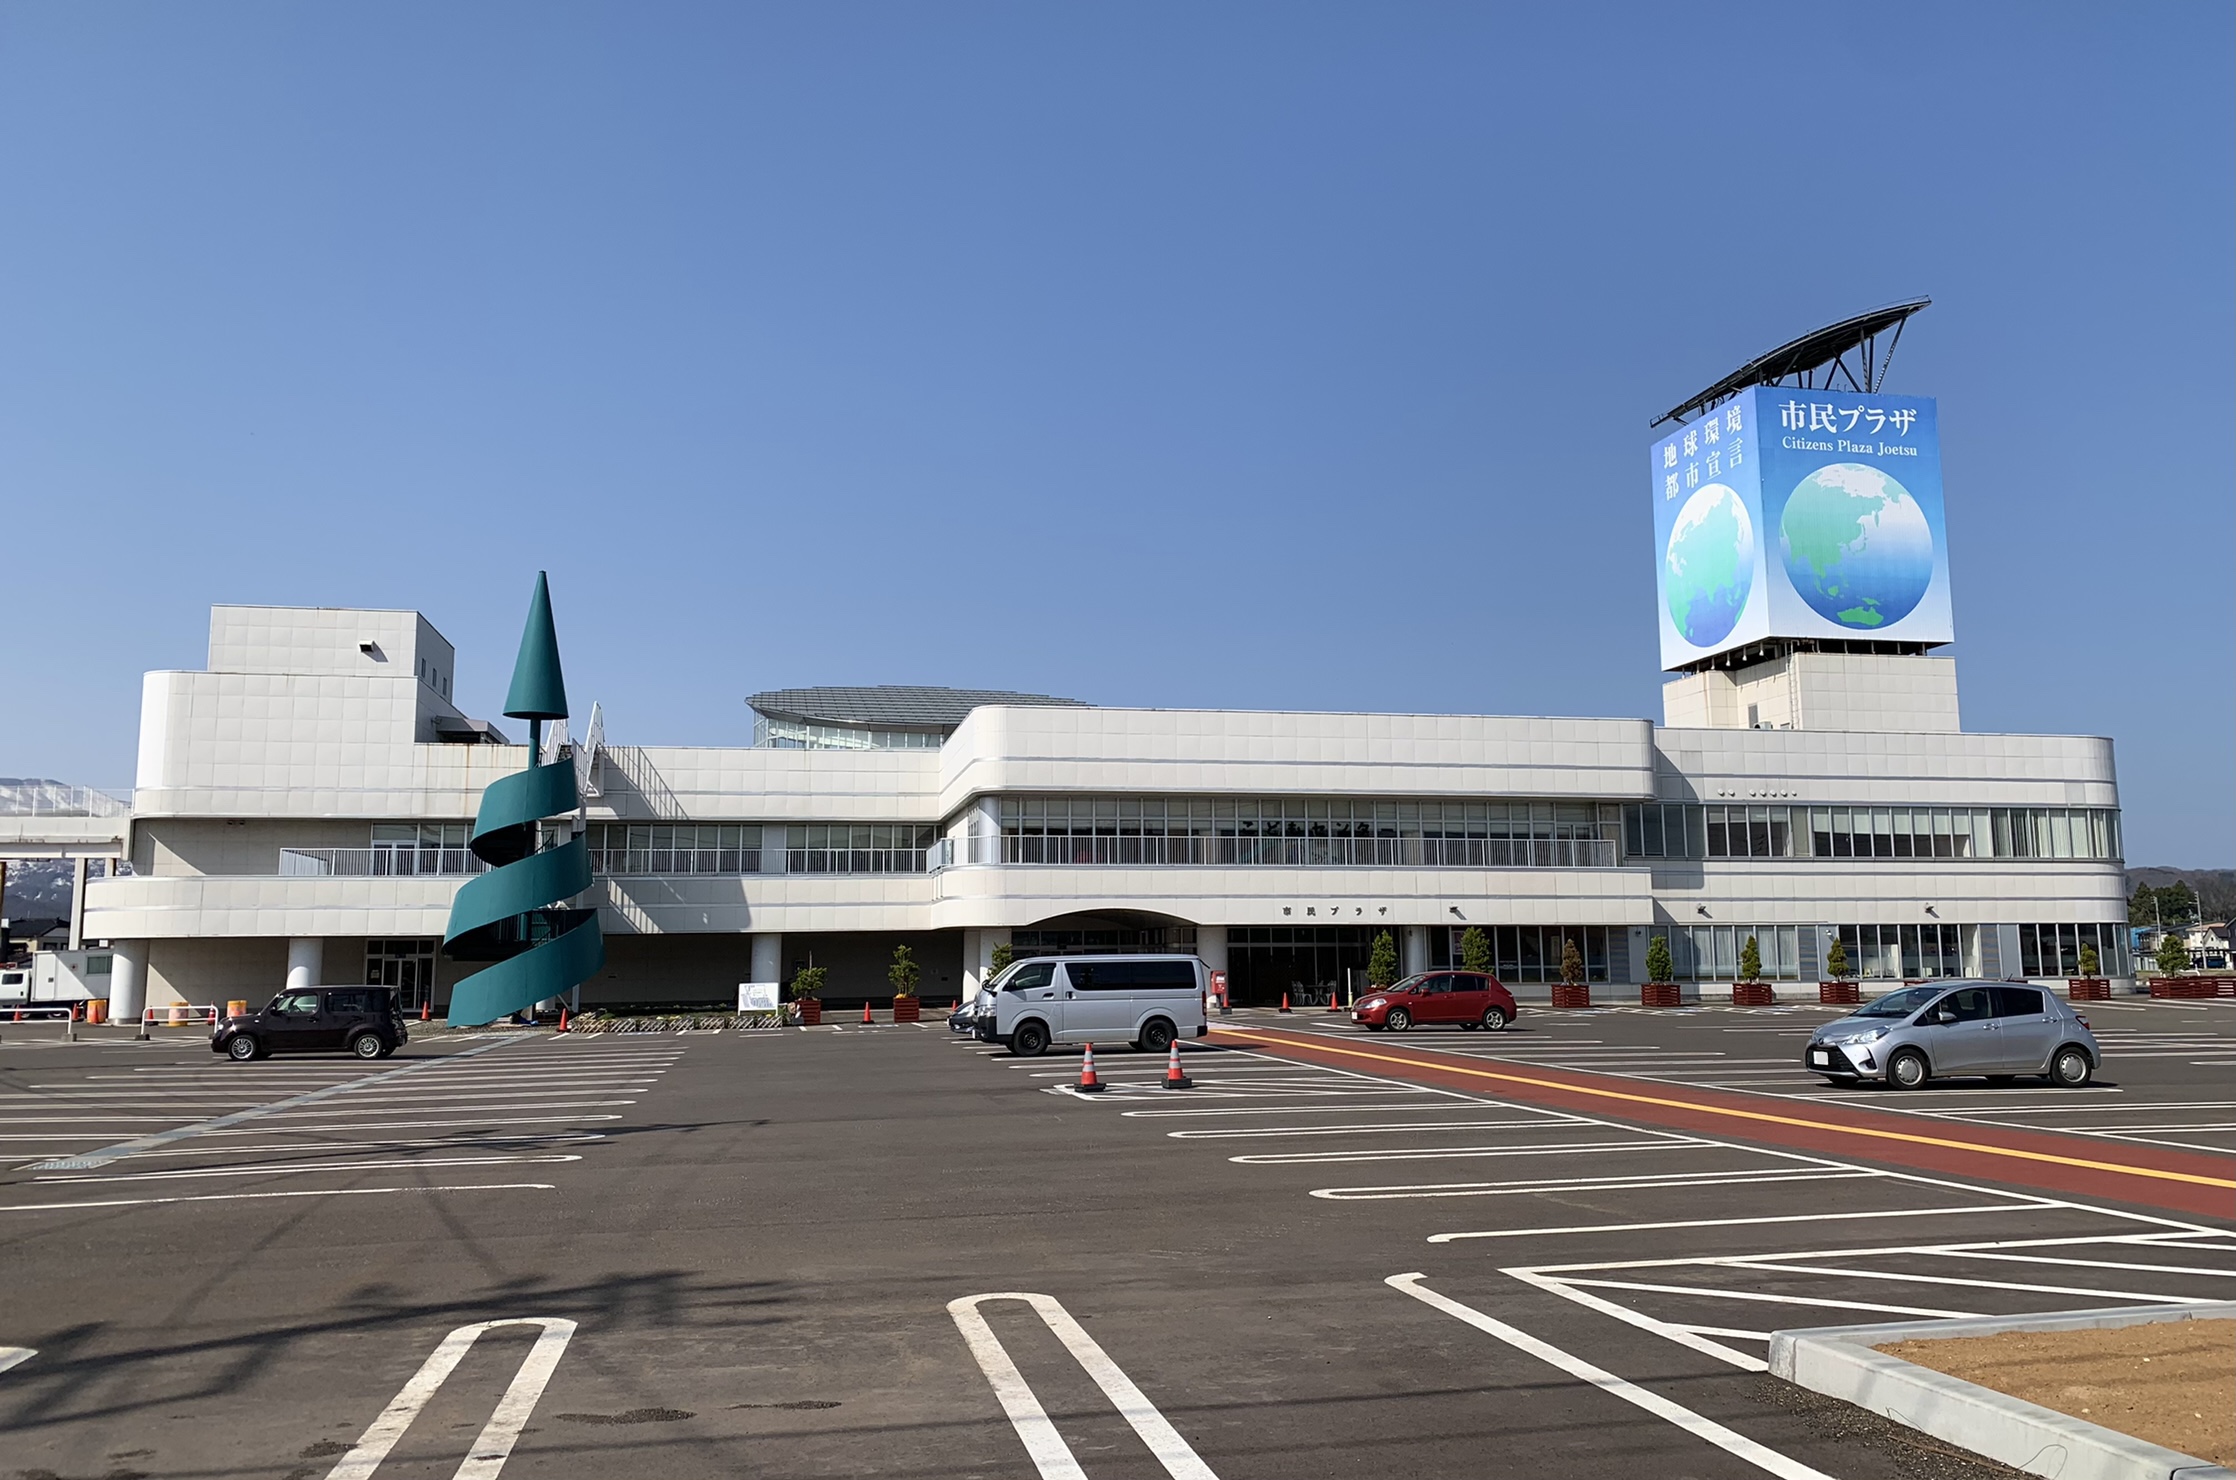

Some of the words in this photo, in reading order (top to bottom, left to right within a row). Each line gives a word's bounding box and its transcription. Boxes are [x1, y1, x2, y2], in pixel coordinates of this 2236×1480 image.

[1664, 405, 1742, 469] 地球環境
[1778, 400, 1917, 437] 市民プラザ
[1782, 436, 1834, 452] Citizens
[1837, 439, 1873, 454] Plaza
[1877, 442, 1918, 456] Joetsu
[1665, 437, 1743, 501] 都市宣言
[1282, 906, 1387, 917] 市民プラザ
